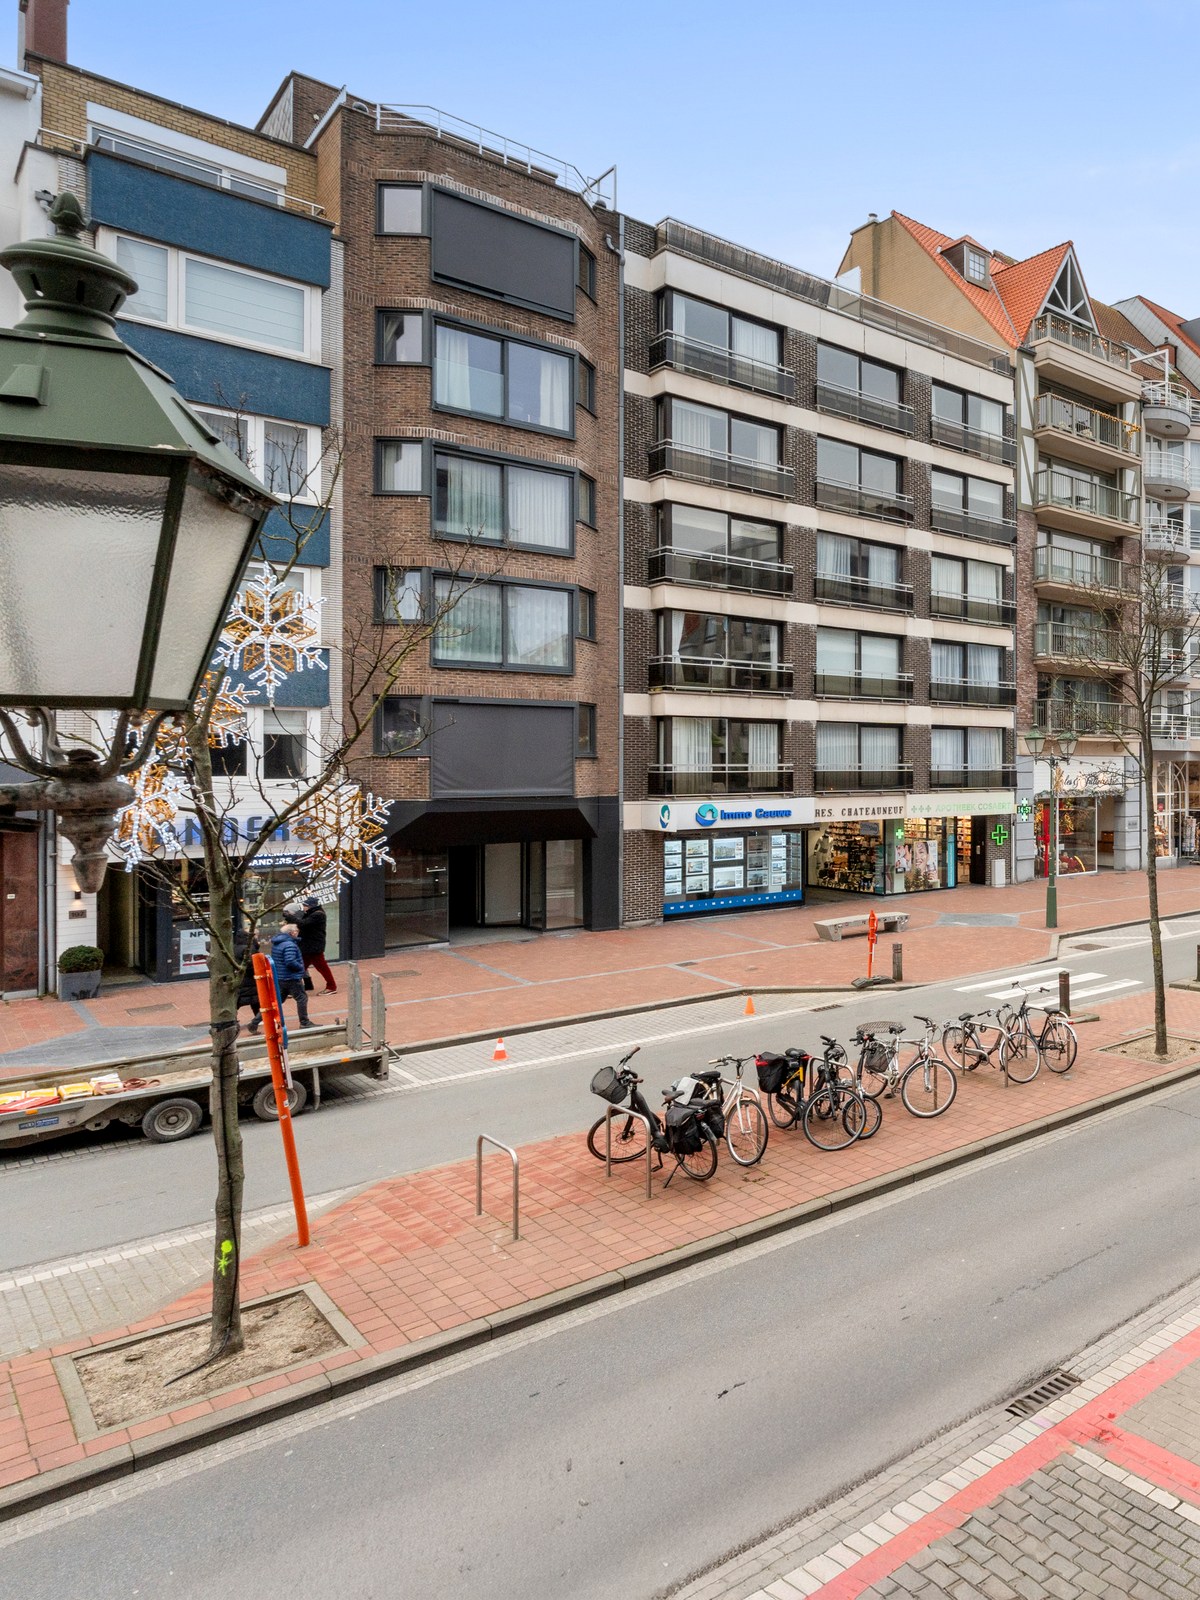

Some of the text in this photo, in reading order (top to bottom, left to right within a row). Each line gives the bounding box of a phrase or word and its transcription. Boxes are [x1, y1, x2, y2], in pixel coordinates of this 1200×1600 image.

[814, 806, 904, 818] RES. CHATEAUNEUF
[935, 801, 1011, 812] APOTHEEK COSAERT
[720, 807, 792, 821] Immo Cauwe
